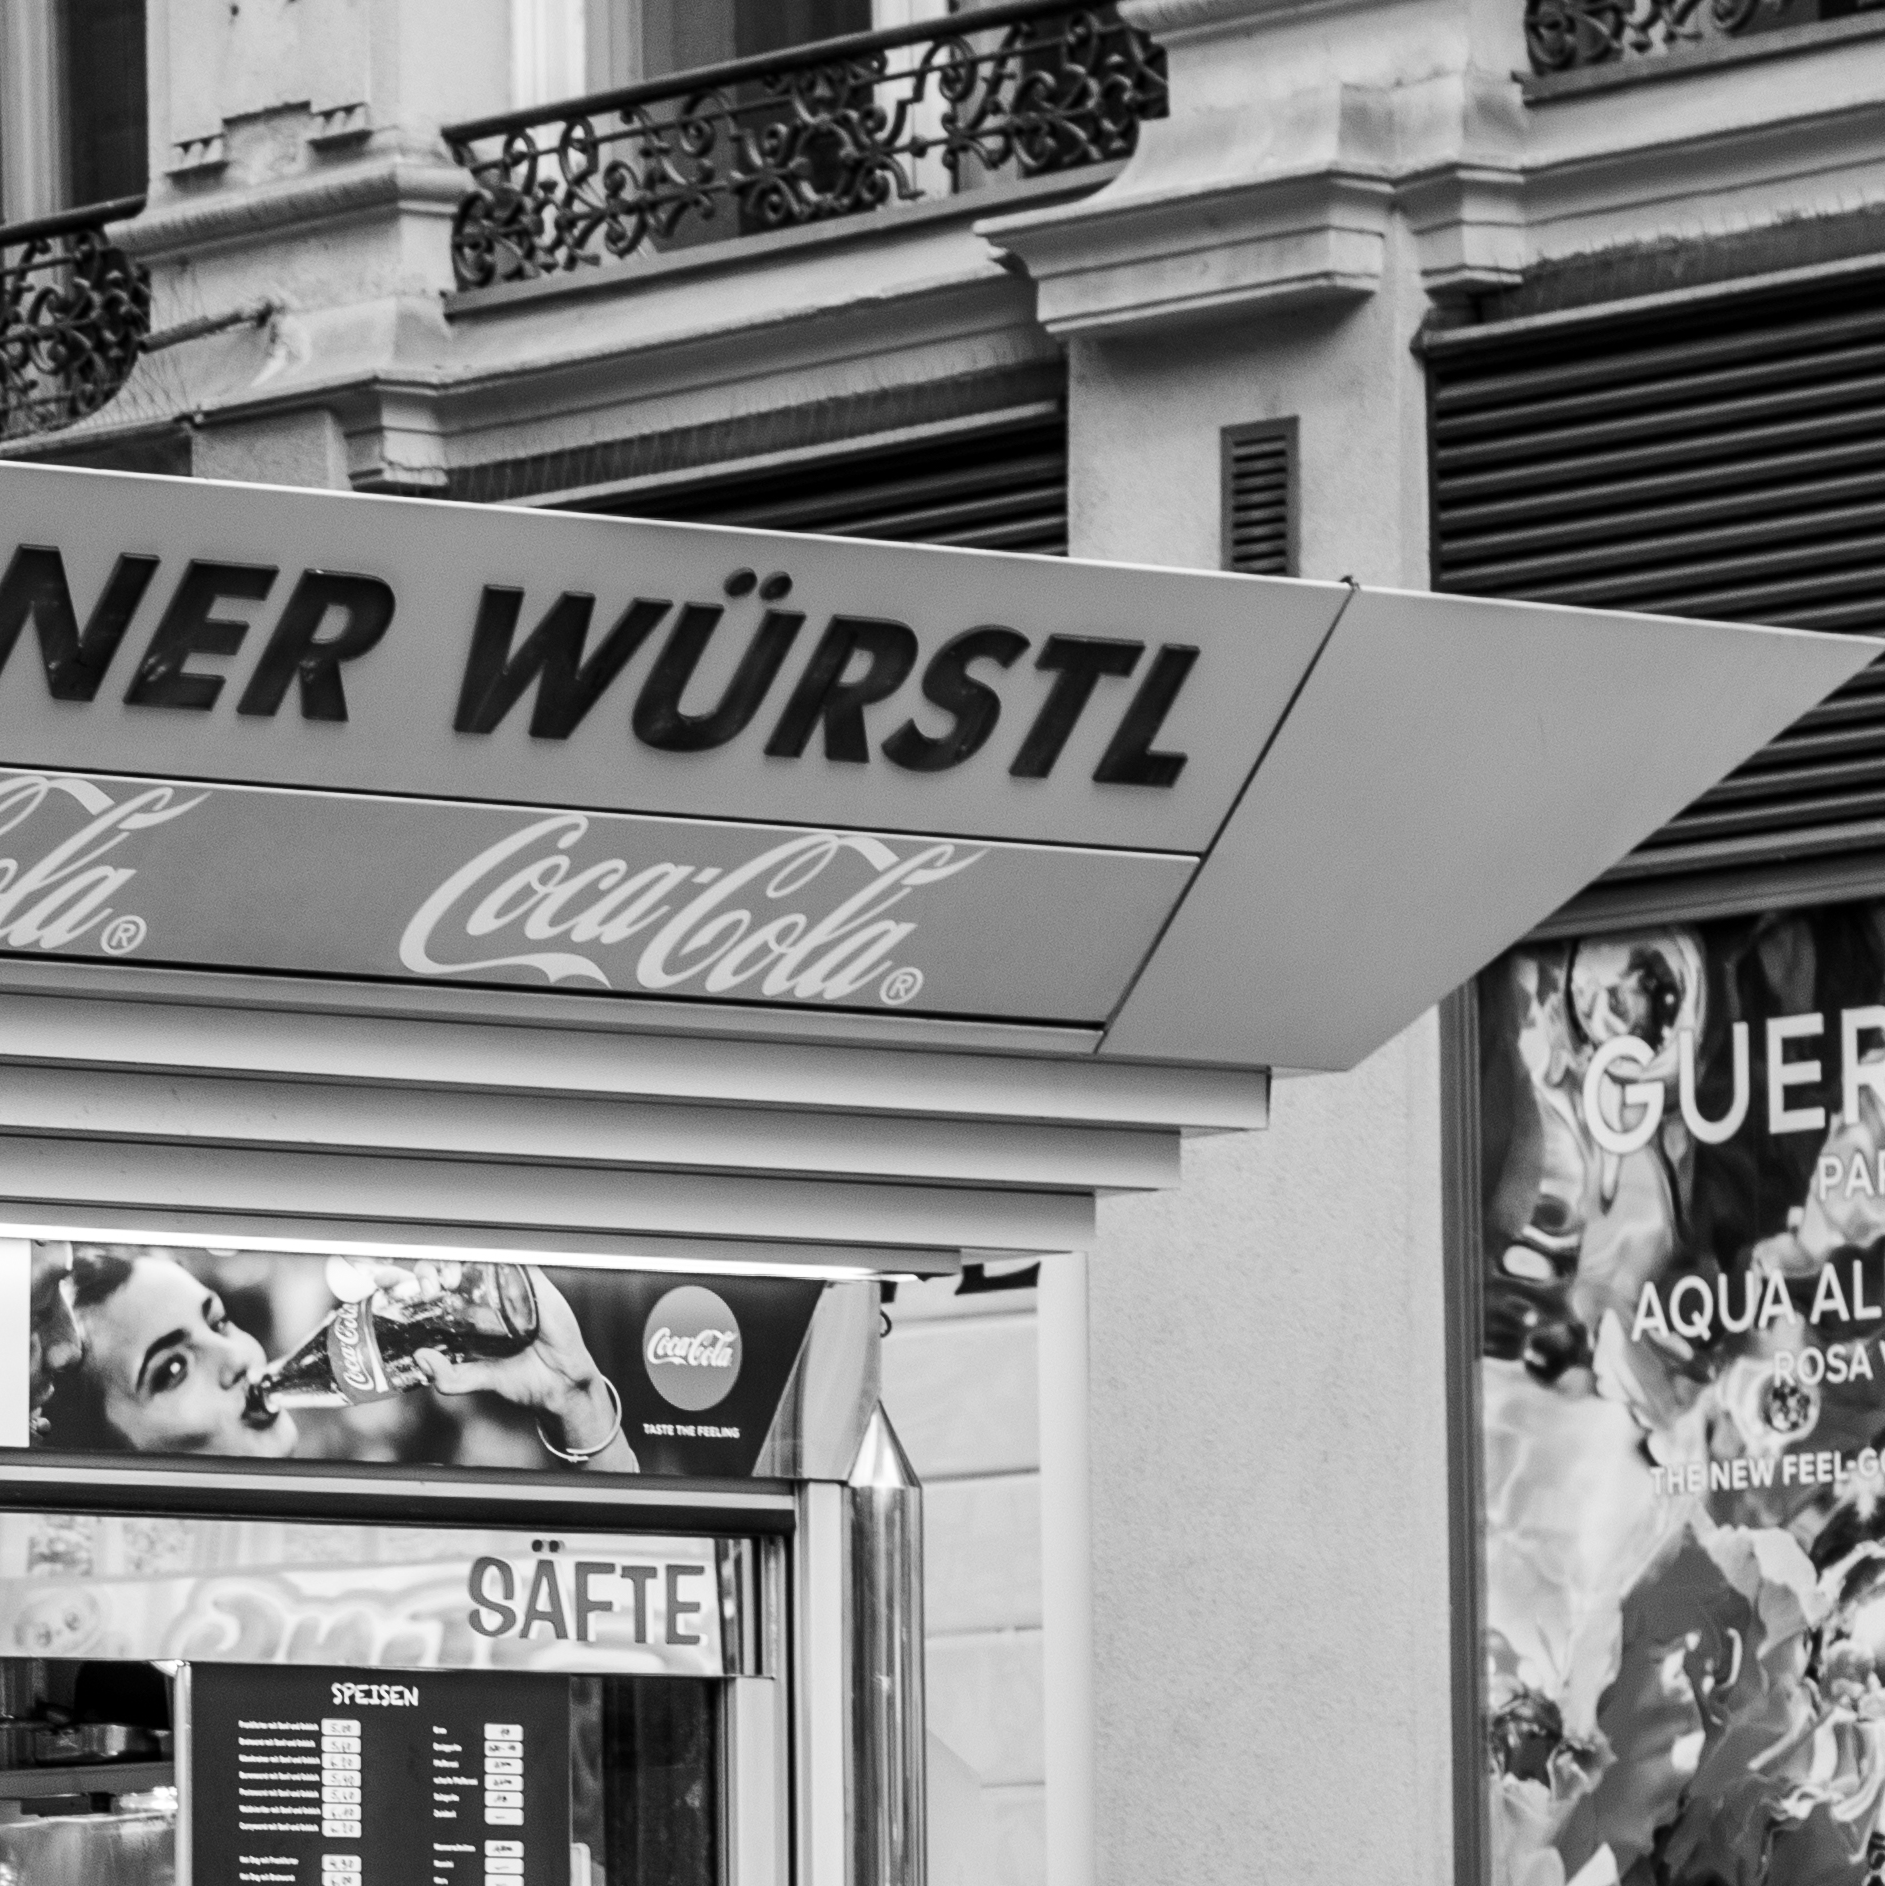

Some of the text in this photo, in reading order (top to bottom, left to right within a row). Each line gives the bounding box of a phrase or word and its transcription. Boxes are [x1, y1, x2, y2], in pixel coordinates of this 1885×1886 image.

[451, 566, 1201, 788] WÜRSTL
[399, 808, 987, 1000] Coca-Cola
[1631, 1268, 1798, 1342] AQUA
[1772, 1342, 1875, 1388] ROSA
[642, 1422, 741, 1439] TASTE THE FEELING
[1710, 1457, 1776, 1492] NEW
[465, 1538, 709, 1647] SÄFTE
[331, 1682, 420, 1708] SPEISEN
